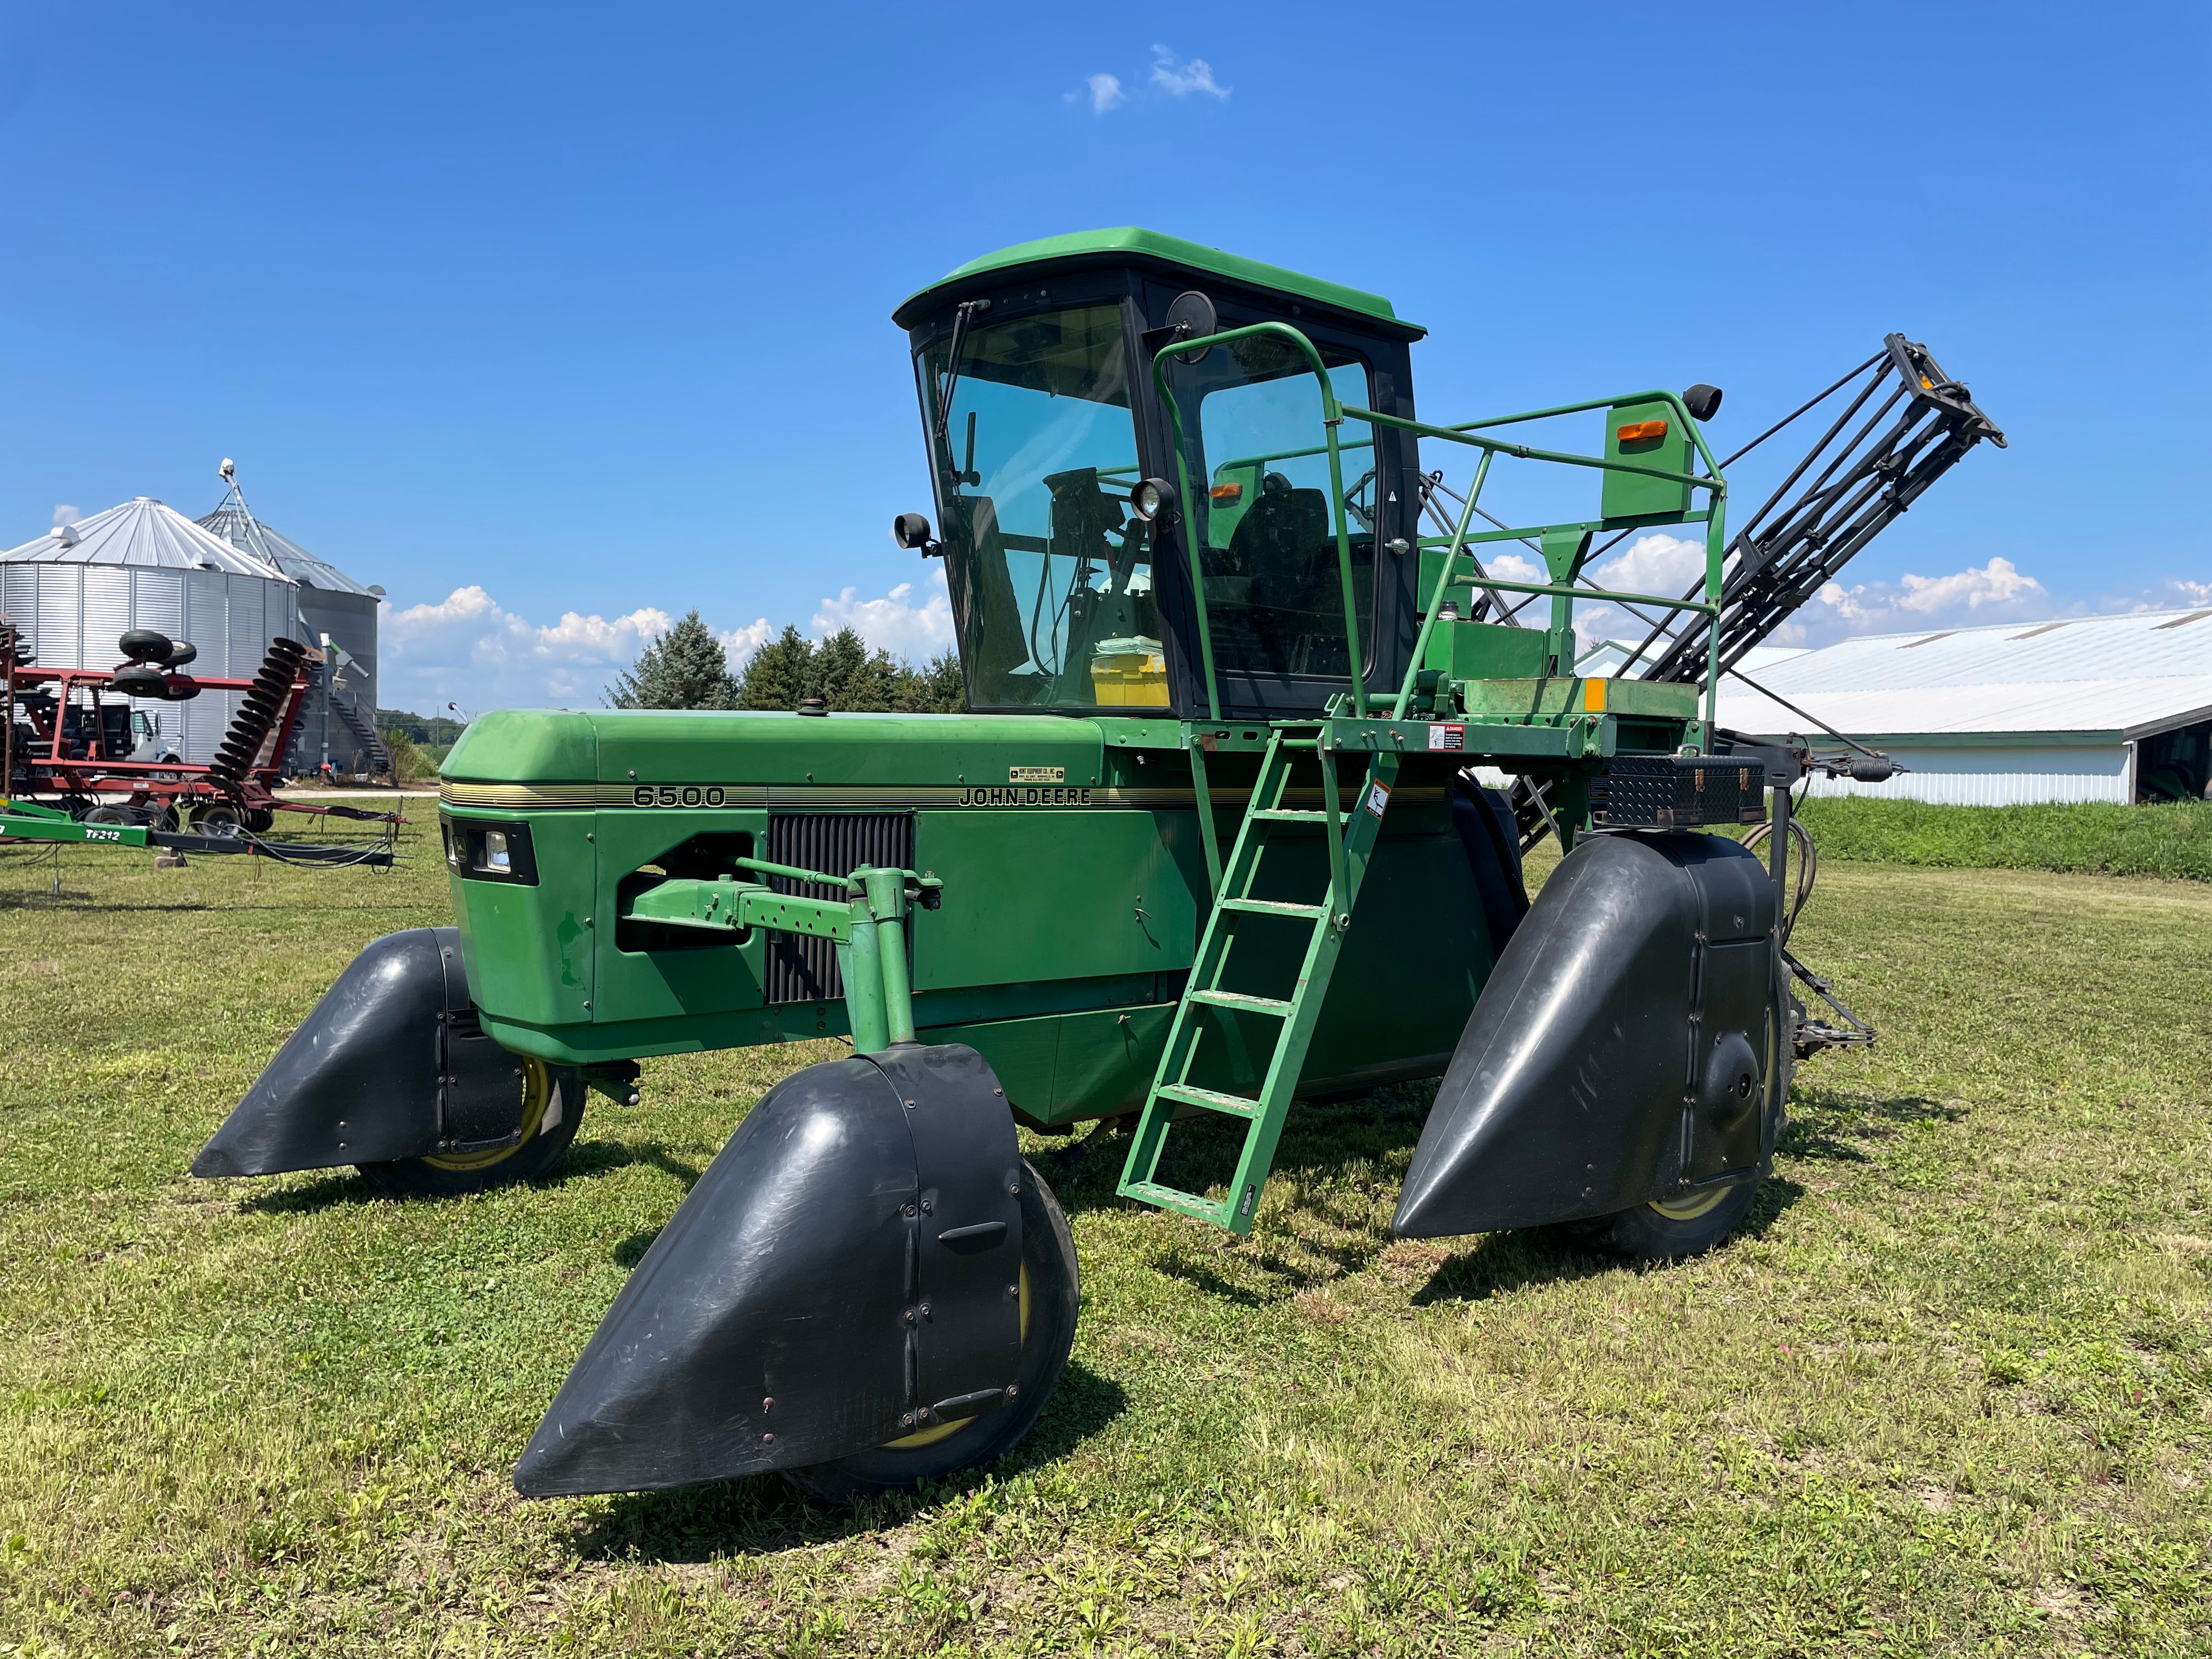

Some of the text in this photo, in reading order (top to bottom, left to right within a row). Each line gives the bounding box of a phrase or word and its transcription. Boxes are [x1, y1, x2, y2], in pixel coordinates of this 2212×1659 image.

[633, 786, 725, 808] 6500
[958, 788, 1091, 806] JOHN DEERE
[86, 829, 120, 841] TF212
